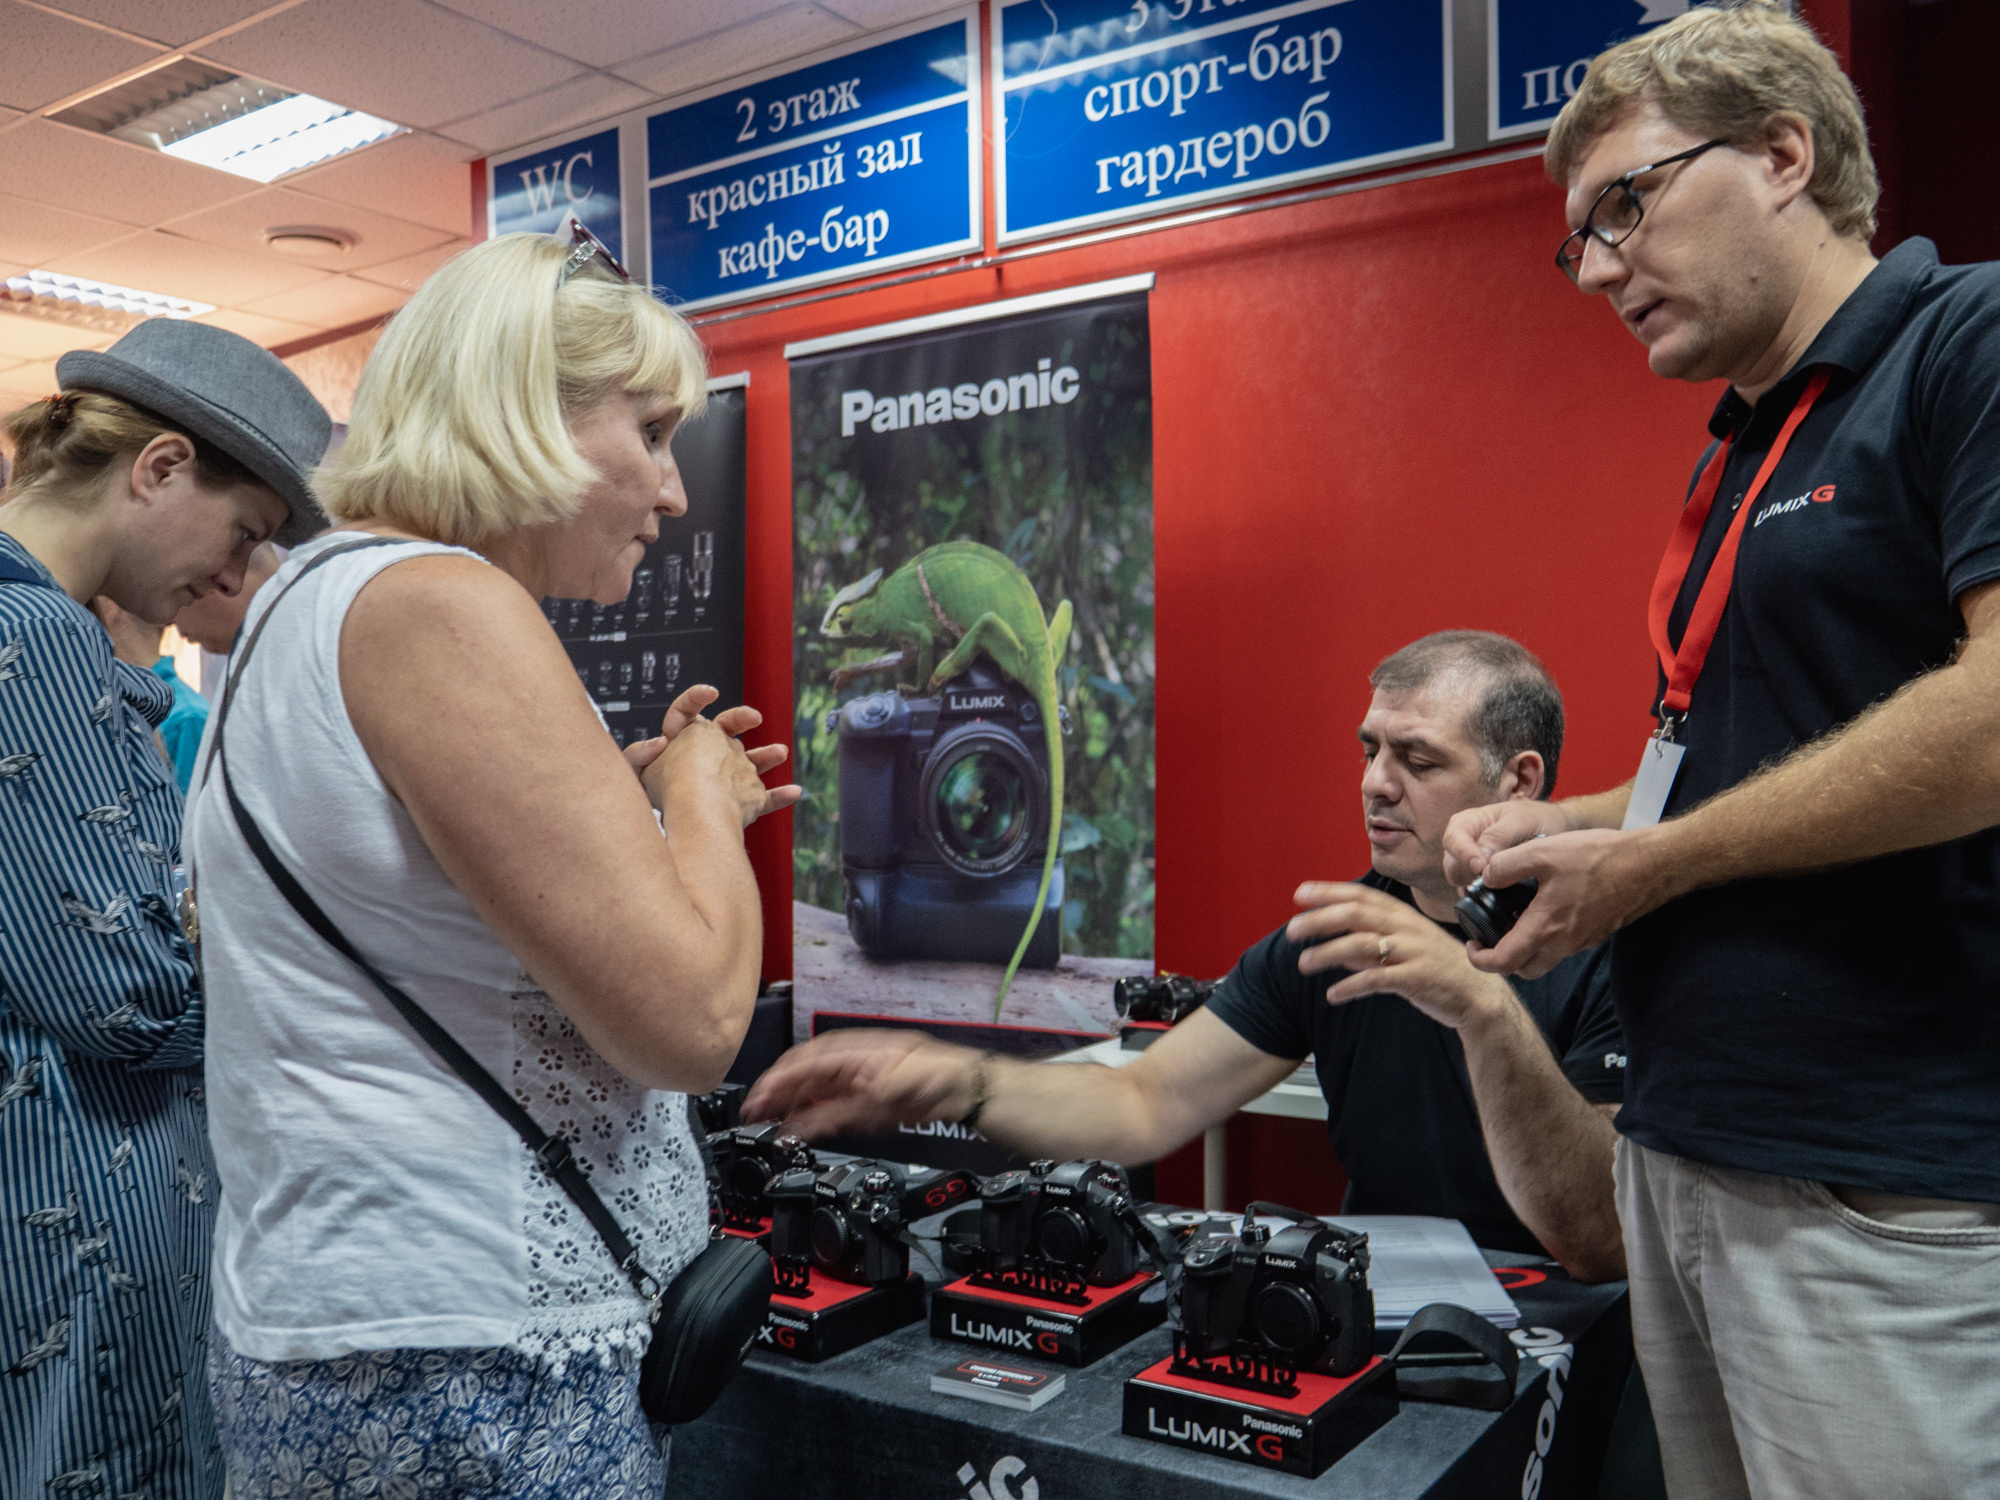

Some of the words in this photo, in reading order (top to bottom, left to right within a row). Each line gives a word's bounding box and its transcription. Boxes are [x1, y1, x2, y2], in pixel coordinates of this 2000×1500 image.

[1083, 24, 1343, 122] спорт-бар
[735, 98, 758, 143] 2
[768, 77, 861, 134] этаж
[1095, 91, 1331, 198] гардероб
[520, 151, 595, 217] WC
[687, 141, 846, 231] красный
[856, 131, 924, 179] зал
[718, 206, 890, 280] кафе-бар
[841, 358, 1080, 437] Panasonic
[1754, 491, 1812, 528] LUMIX
[1812, 484, 1836, 502] G
[951, 695, 1006, 710] LUMIX
[1265, 1254, 1297, 1269] LUMIX
[768, 1312, 810, 1332] Panasonic
[950, 1314, 1033, 1351] LUMIX
[1037, 1332, 1060, 1355] G
[1026, 1316, 1075, 1335] Panasonic
[1149, 1408, 1252, 1456] LUMIX
[1256, 1436, 1283, 1462] G
[1243, 1414, 1304, 1440] Panasonic
